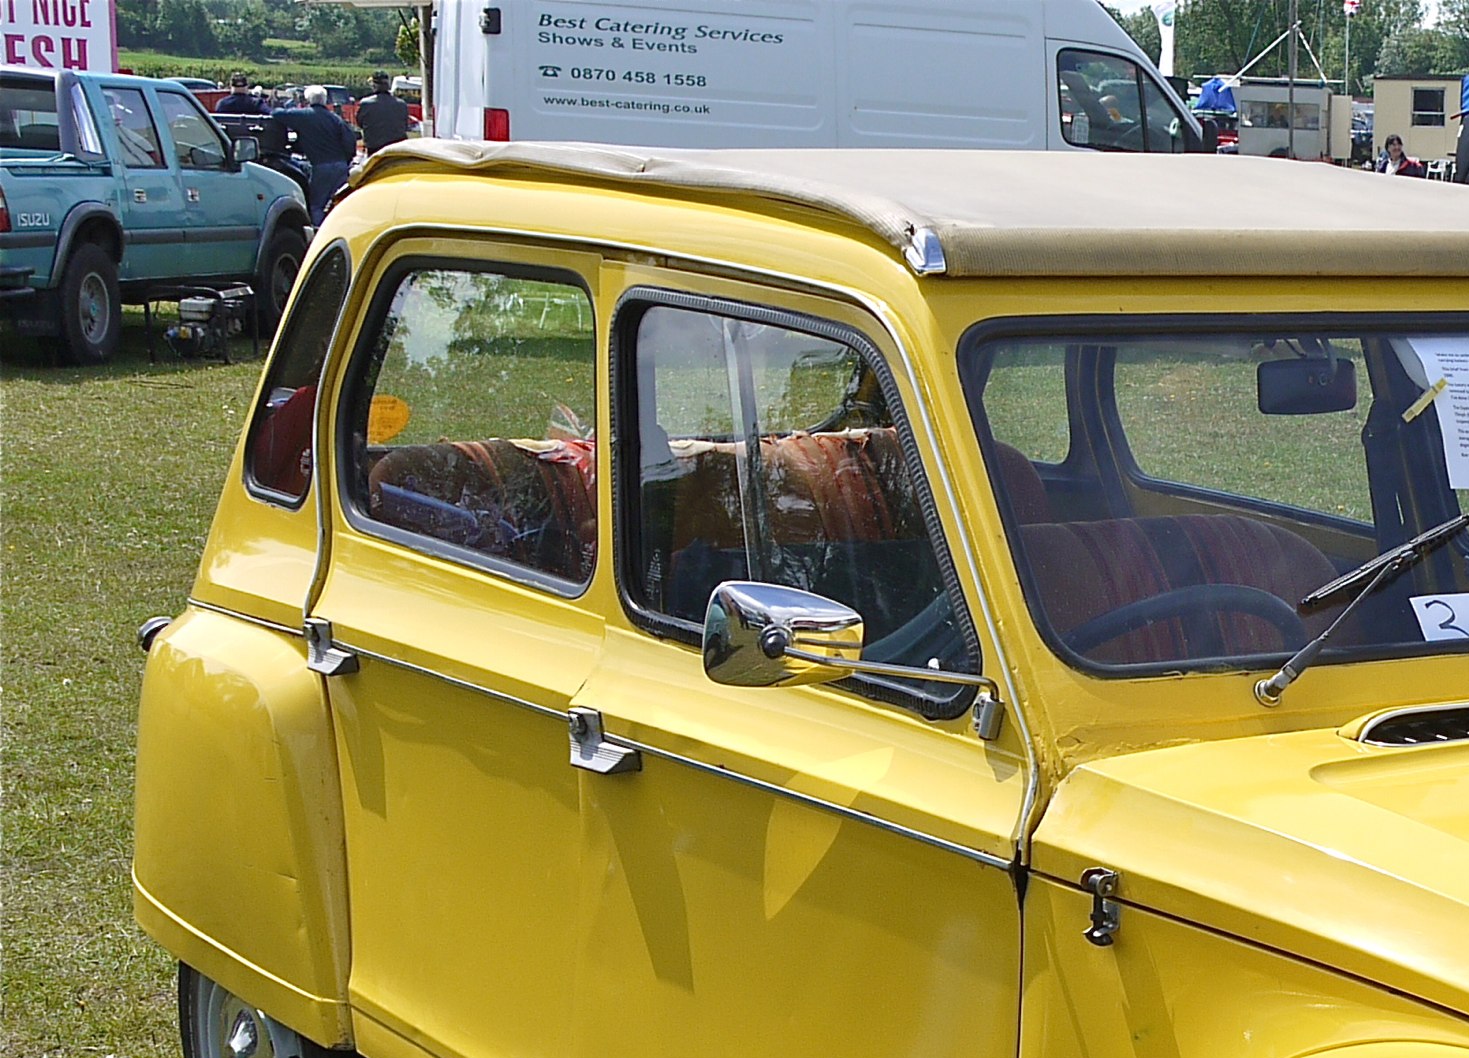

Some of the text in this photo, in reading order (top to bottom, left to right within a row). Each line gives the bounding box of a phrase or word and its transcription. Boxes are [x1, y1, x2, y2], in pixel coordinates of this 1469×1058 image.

[538, 13, 784, 44] Best Catering Services
[538, 31, 698, 54] Shows & Events
[570, 67, 707, 88] 0870 458 1558
[543, 96, 710, 114] www.best-catering.co.uk
[17, 213, 50, 226] ISUZU
